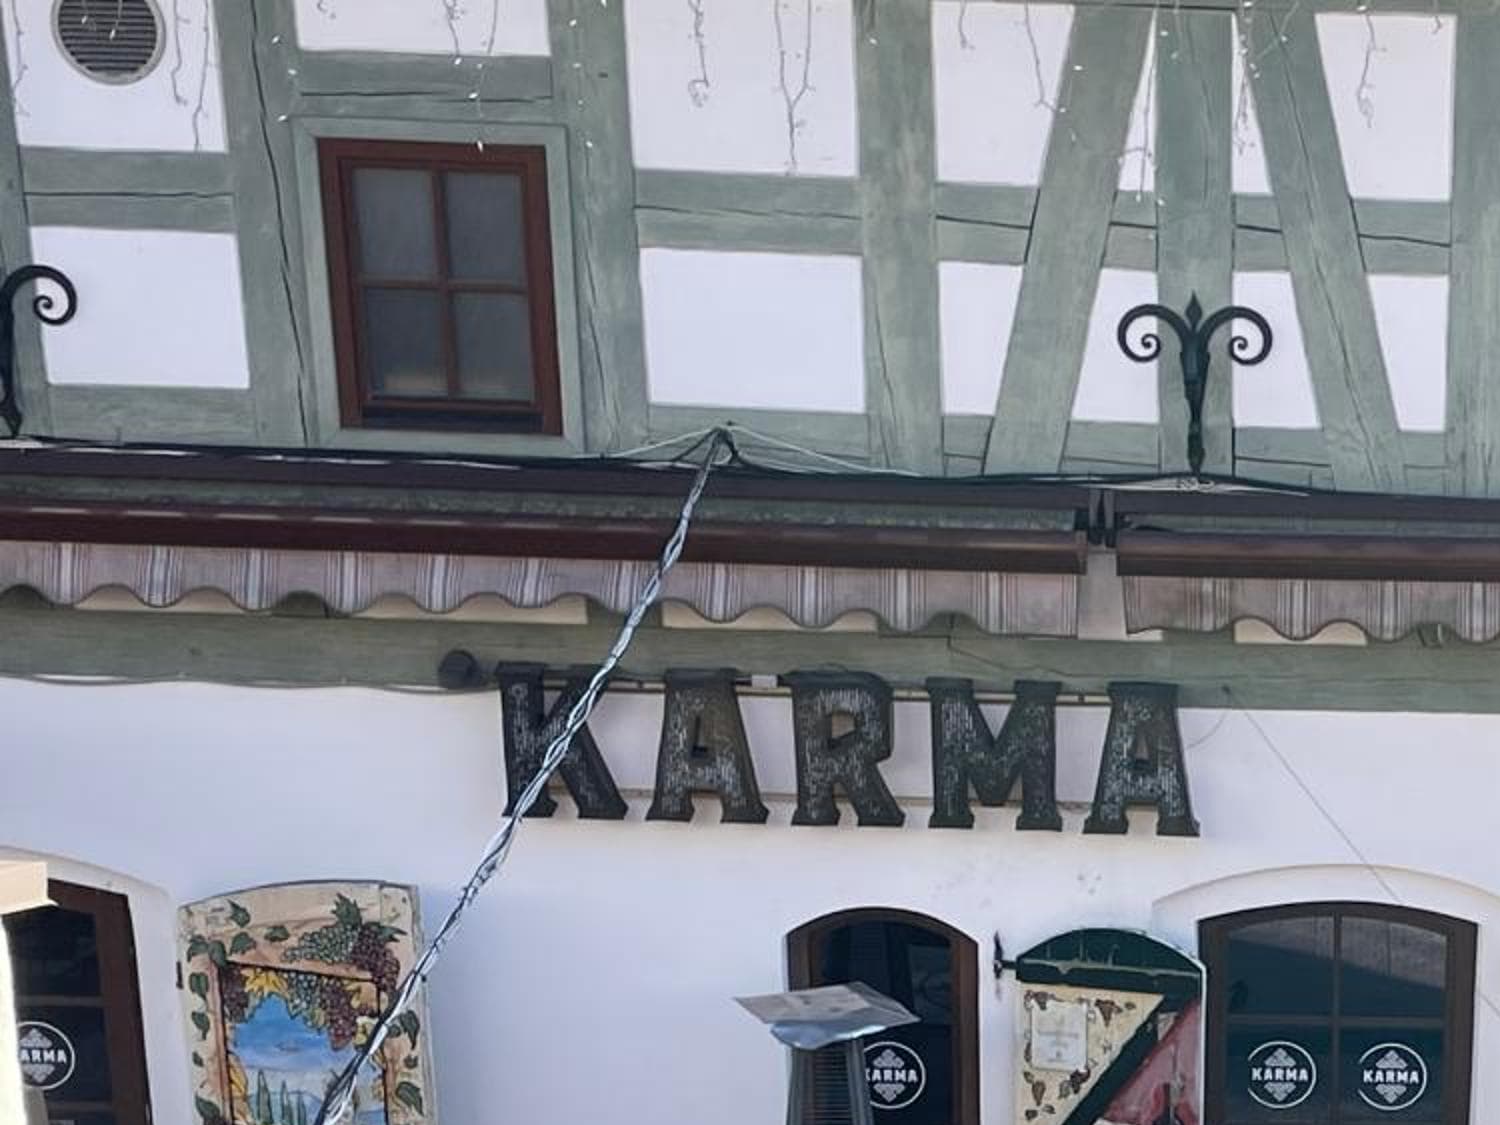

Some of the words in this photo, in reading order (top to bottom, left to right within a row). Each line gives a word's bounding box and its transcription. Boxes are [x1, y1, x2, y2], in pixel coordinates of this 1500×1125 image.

[498, 662, 1200, 836] KARMA
[20, 1049, 67, 1063] ARMA
[1251, 1067, 1308, 1081] KARMA
[1363, 1069, 1419, 1083] KARMA
